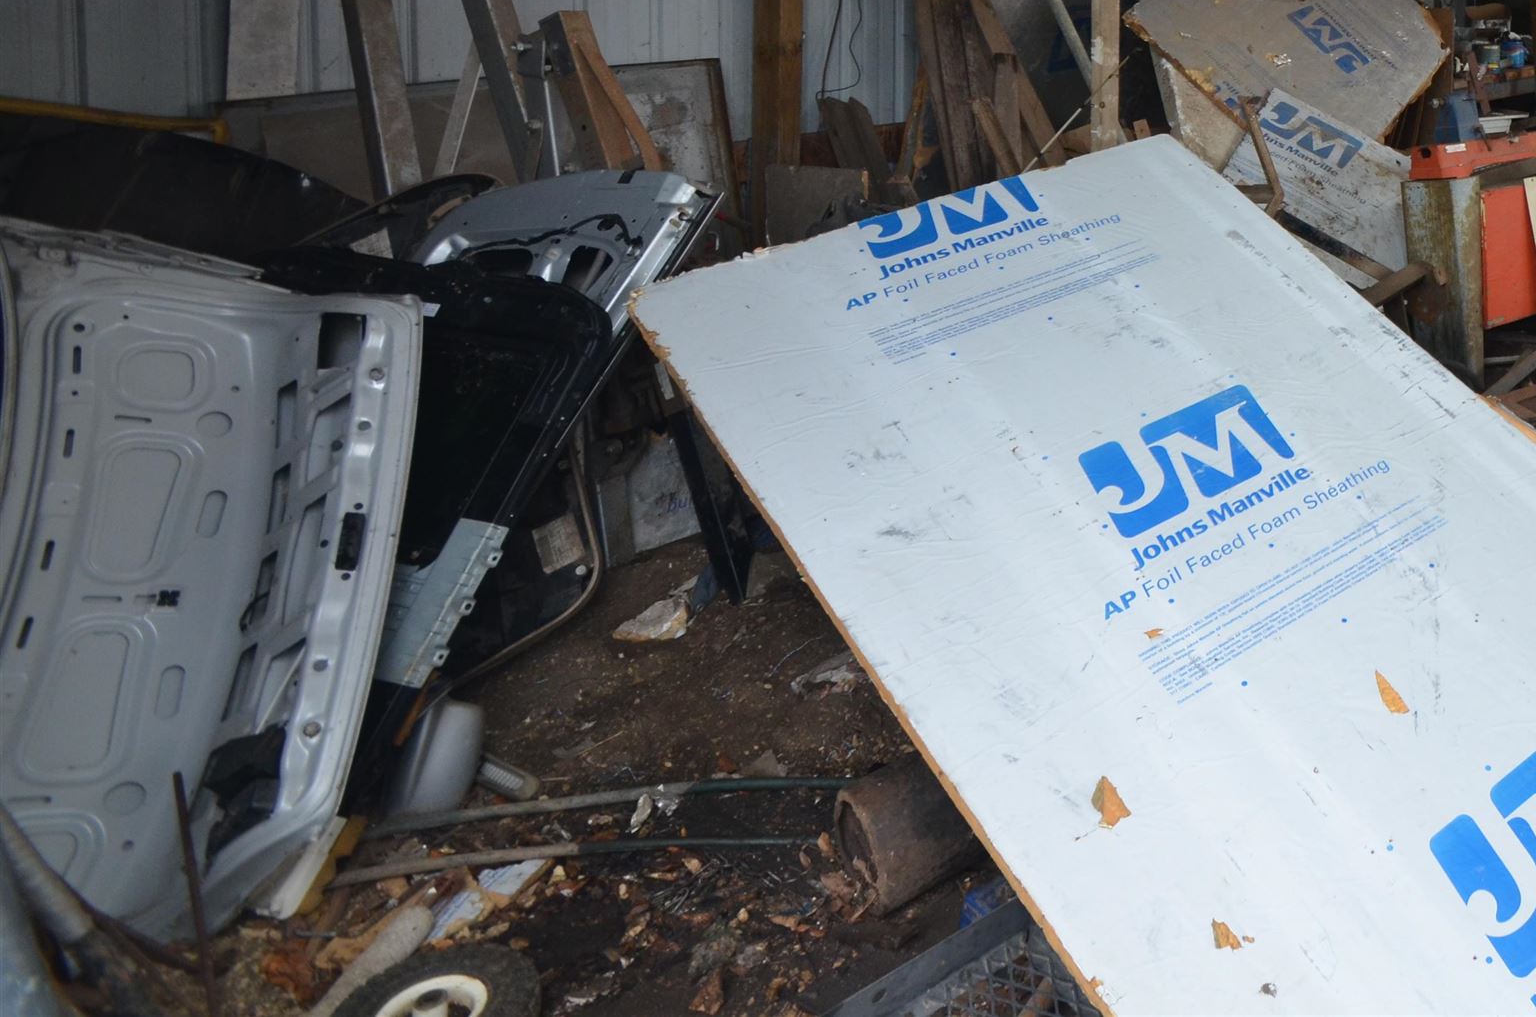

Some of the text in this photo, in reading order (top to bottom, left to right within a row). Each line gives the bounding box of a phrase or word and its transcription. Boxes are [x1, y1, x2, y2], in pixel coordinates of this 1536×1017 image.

[1287, 5, 1370, 74] JM
[1260, 101, 1363, 169] JM
[1286, 143, 1339, 177] Manville
[858, 174, 1039, 259] JM
[879, 215, 1049, 280] Johns Manville
[846, 214, 1122, 311] AP Foil Faced Foam Sheathing
[1078, 384, 1295, 538] JM
[1104, 459, 1391, 620] AP Foil Faced Foam Sheathing
[1130, 465, 1311, 571] Johns Manville
